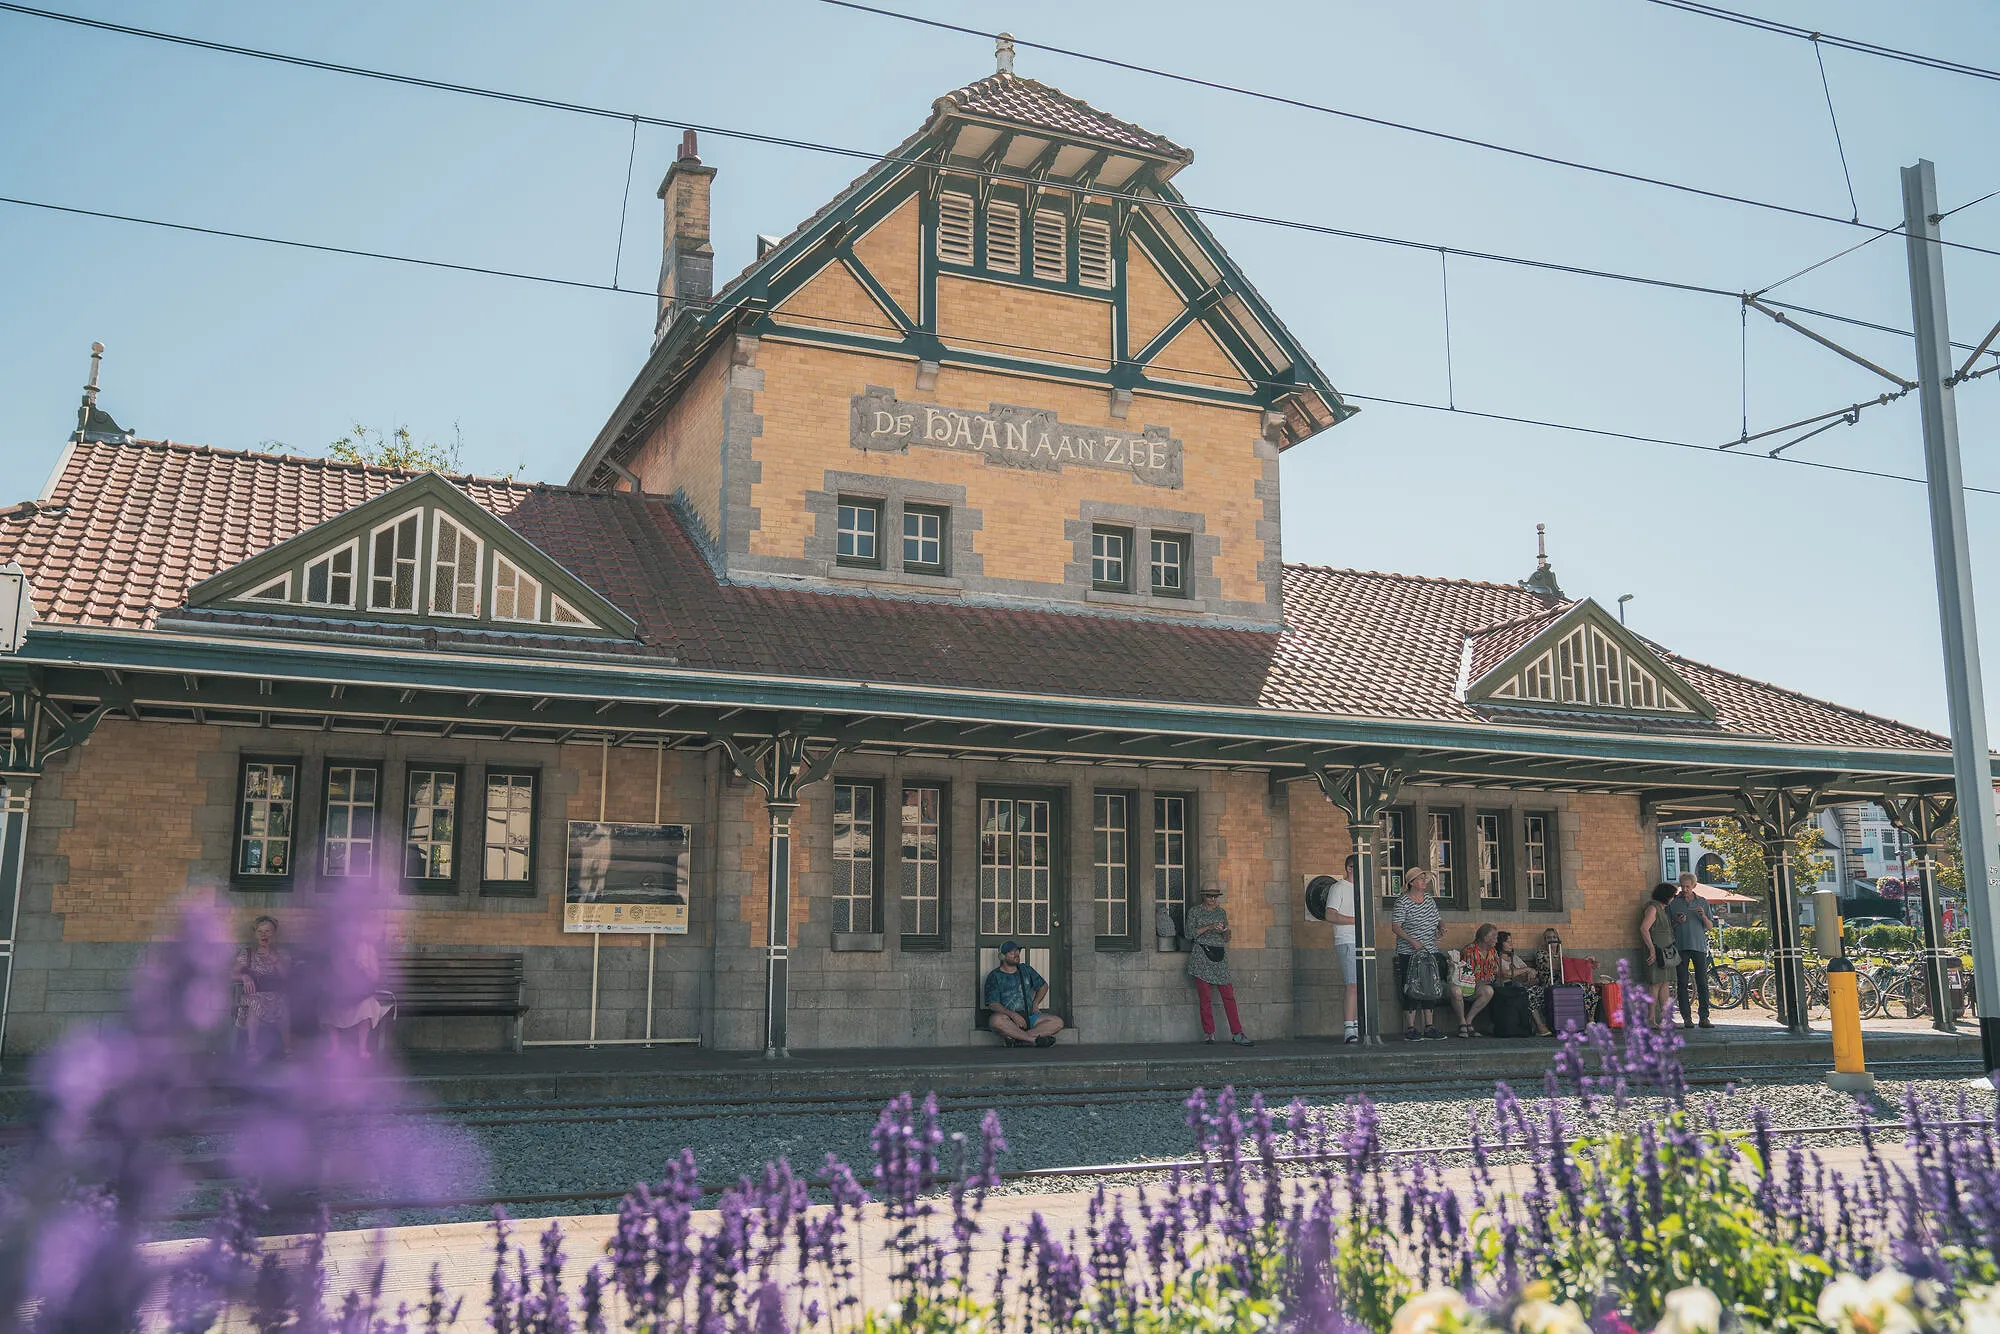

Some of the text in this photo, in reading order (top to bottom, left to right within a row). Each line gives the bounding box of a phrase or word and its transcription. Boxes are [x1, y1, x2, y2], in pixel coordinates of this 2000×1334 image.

[871, 411, 915, 438] DE
[1030, 432, 1098, 461] AAN
[1104, 435, 1168, 470] ZEE
